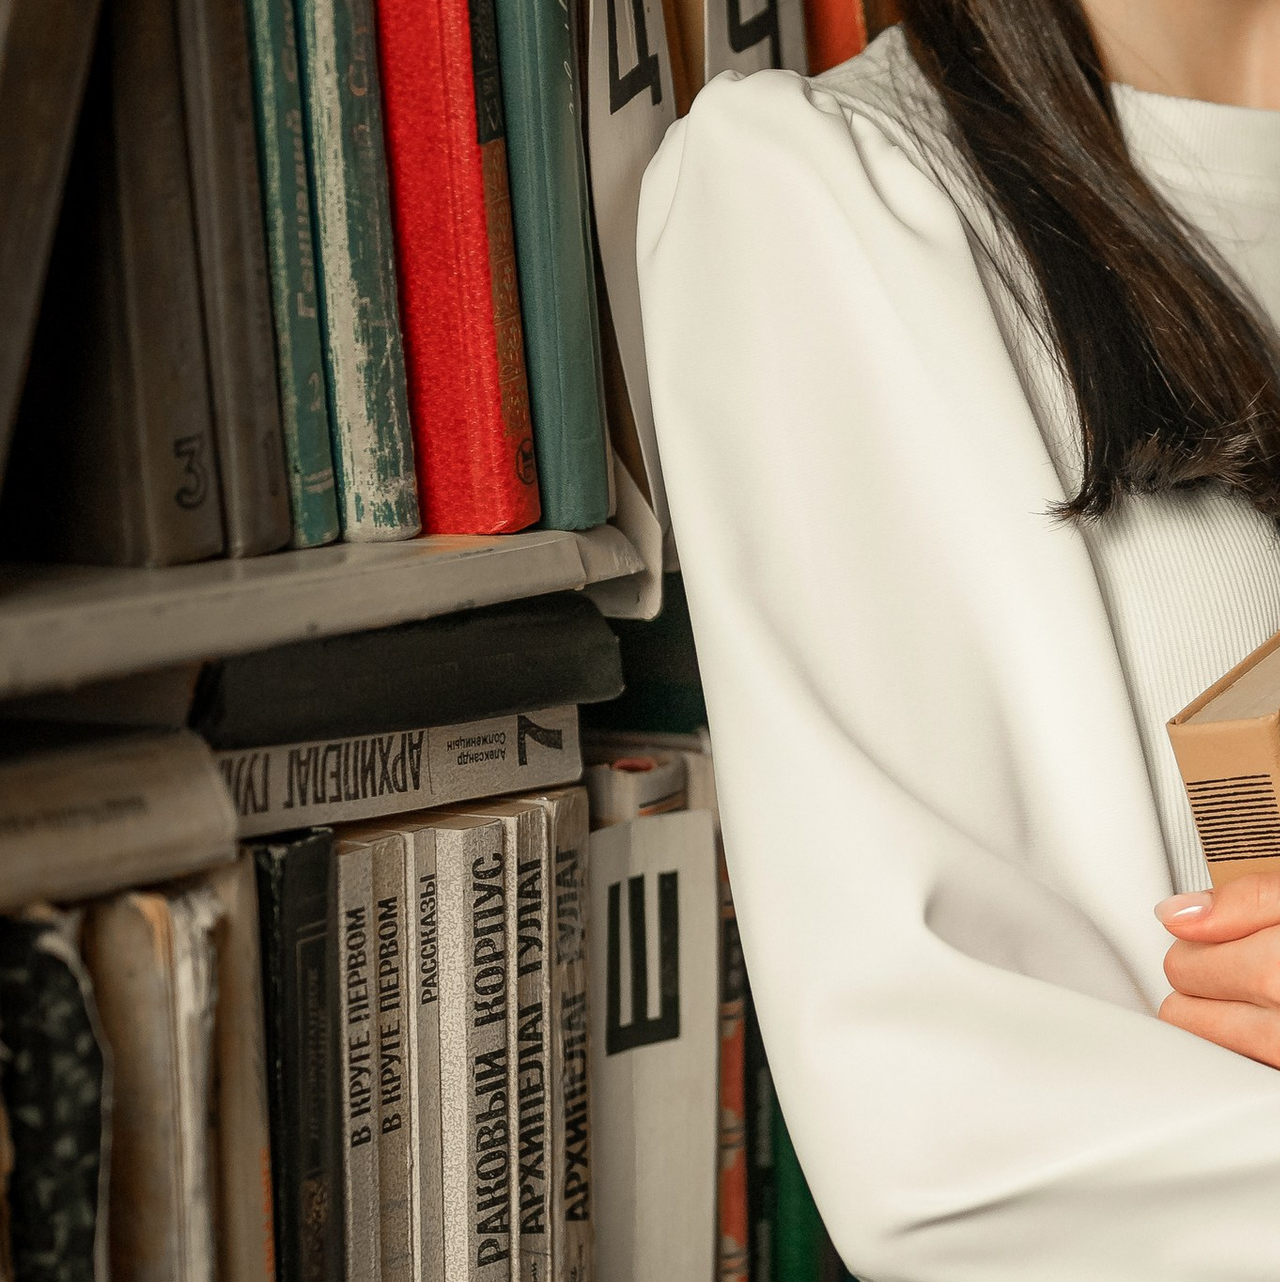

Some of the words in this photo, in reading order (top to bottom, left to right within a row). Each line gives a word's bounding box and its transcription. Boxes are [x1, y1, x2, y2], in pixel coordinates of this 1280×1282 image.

[173, 433, 207, 511] 3
[218, 751, 270, 816] ГУЛ
[282, 730, 426, 809] АРХИПЕЛАГ
[446, 730, 507, 753] Солженицын
[457, 746, 507, 766] Александр
[517, 715, 563, 767] 7
[346, 906, 370, 1025] ПЕРВОМ
[377, 896, 400, 1013] ПЕРВОМ
[419, 873, 437, 1005] РАССКАЗЫ
[472, 853, 508, 1027] КОРПУС
[517, 858, 543, 980] ГУЛАГ
[606, 869, 680, 1057] Ш
[349, 1030, 371, 1126] КРУГЕ
[379, 1019, 402, 1107] КРУГЕ
[561, 991, 590, 1222] АРХИПЕЛАГ
[351, 1126, 372, 1149] В
[381, 1112, 402, 1135] В
[474, 1048, 510, 1268] РАКОВЫЙ
[517, 1002, 545, 1234] АРХИПЕЛАГ
